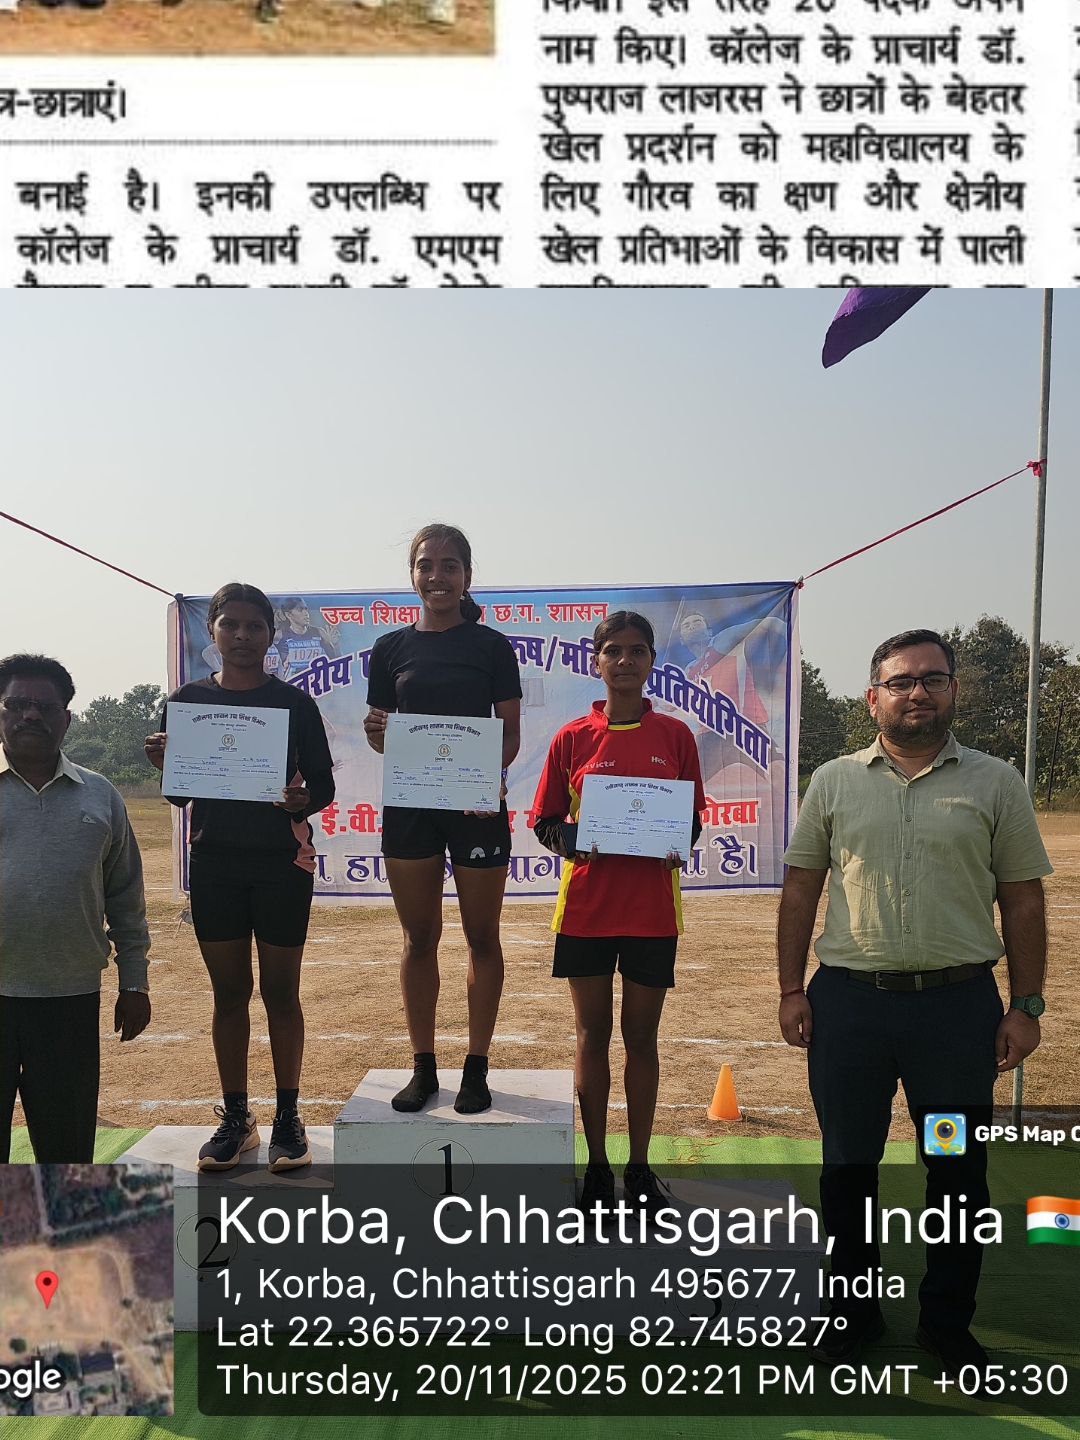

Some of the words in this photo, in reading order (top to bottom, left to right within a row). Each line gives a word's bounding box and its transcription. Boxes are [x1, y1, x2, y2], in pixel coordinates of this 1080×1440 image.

[16, 172, 88, 215] बनाई
[124, 168, 158, 212] है।
[196, 172, 274, 216] इनकी
[307, 172, 428, 211] उपलब्धि
[463, 182, 502, 211] पर
[540, 224, 602, 264] खेल
[617, 224, 743, 264] प्रतिभाओं
[756, 224, 790, 265] के
[804, 225, 903, 264] विकास
[916, 224, 944, 264] में
[958, 225, 1026, 264] पाली
[321, 607, 364, 625] उच्च
[371, 602, 420, 625] शिक्षा
[492, 605, 540, 622] छ.ग.
[547, 603, 608, 622] शासन
[713, 835, 756, 875] है।
